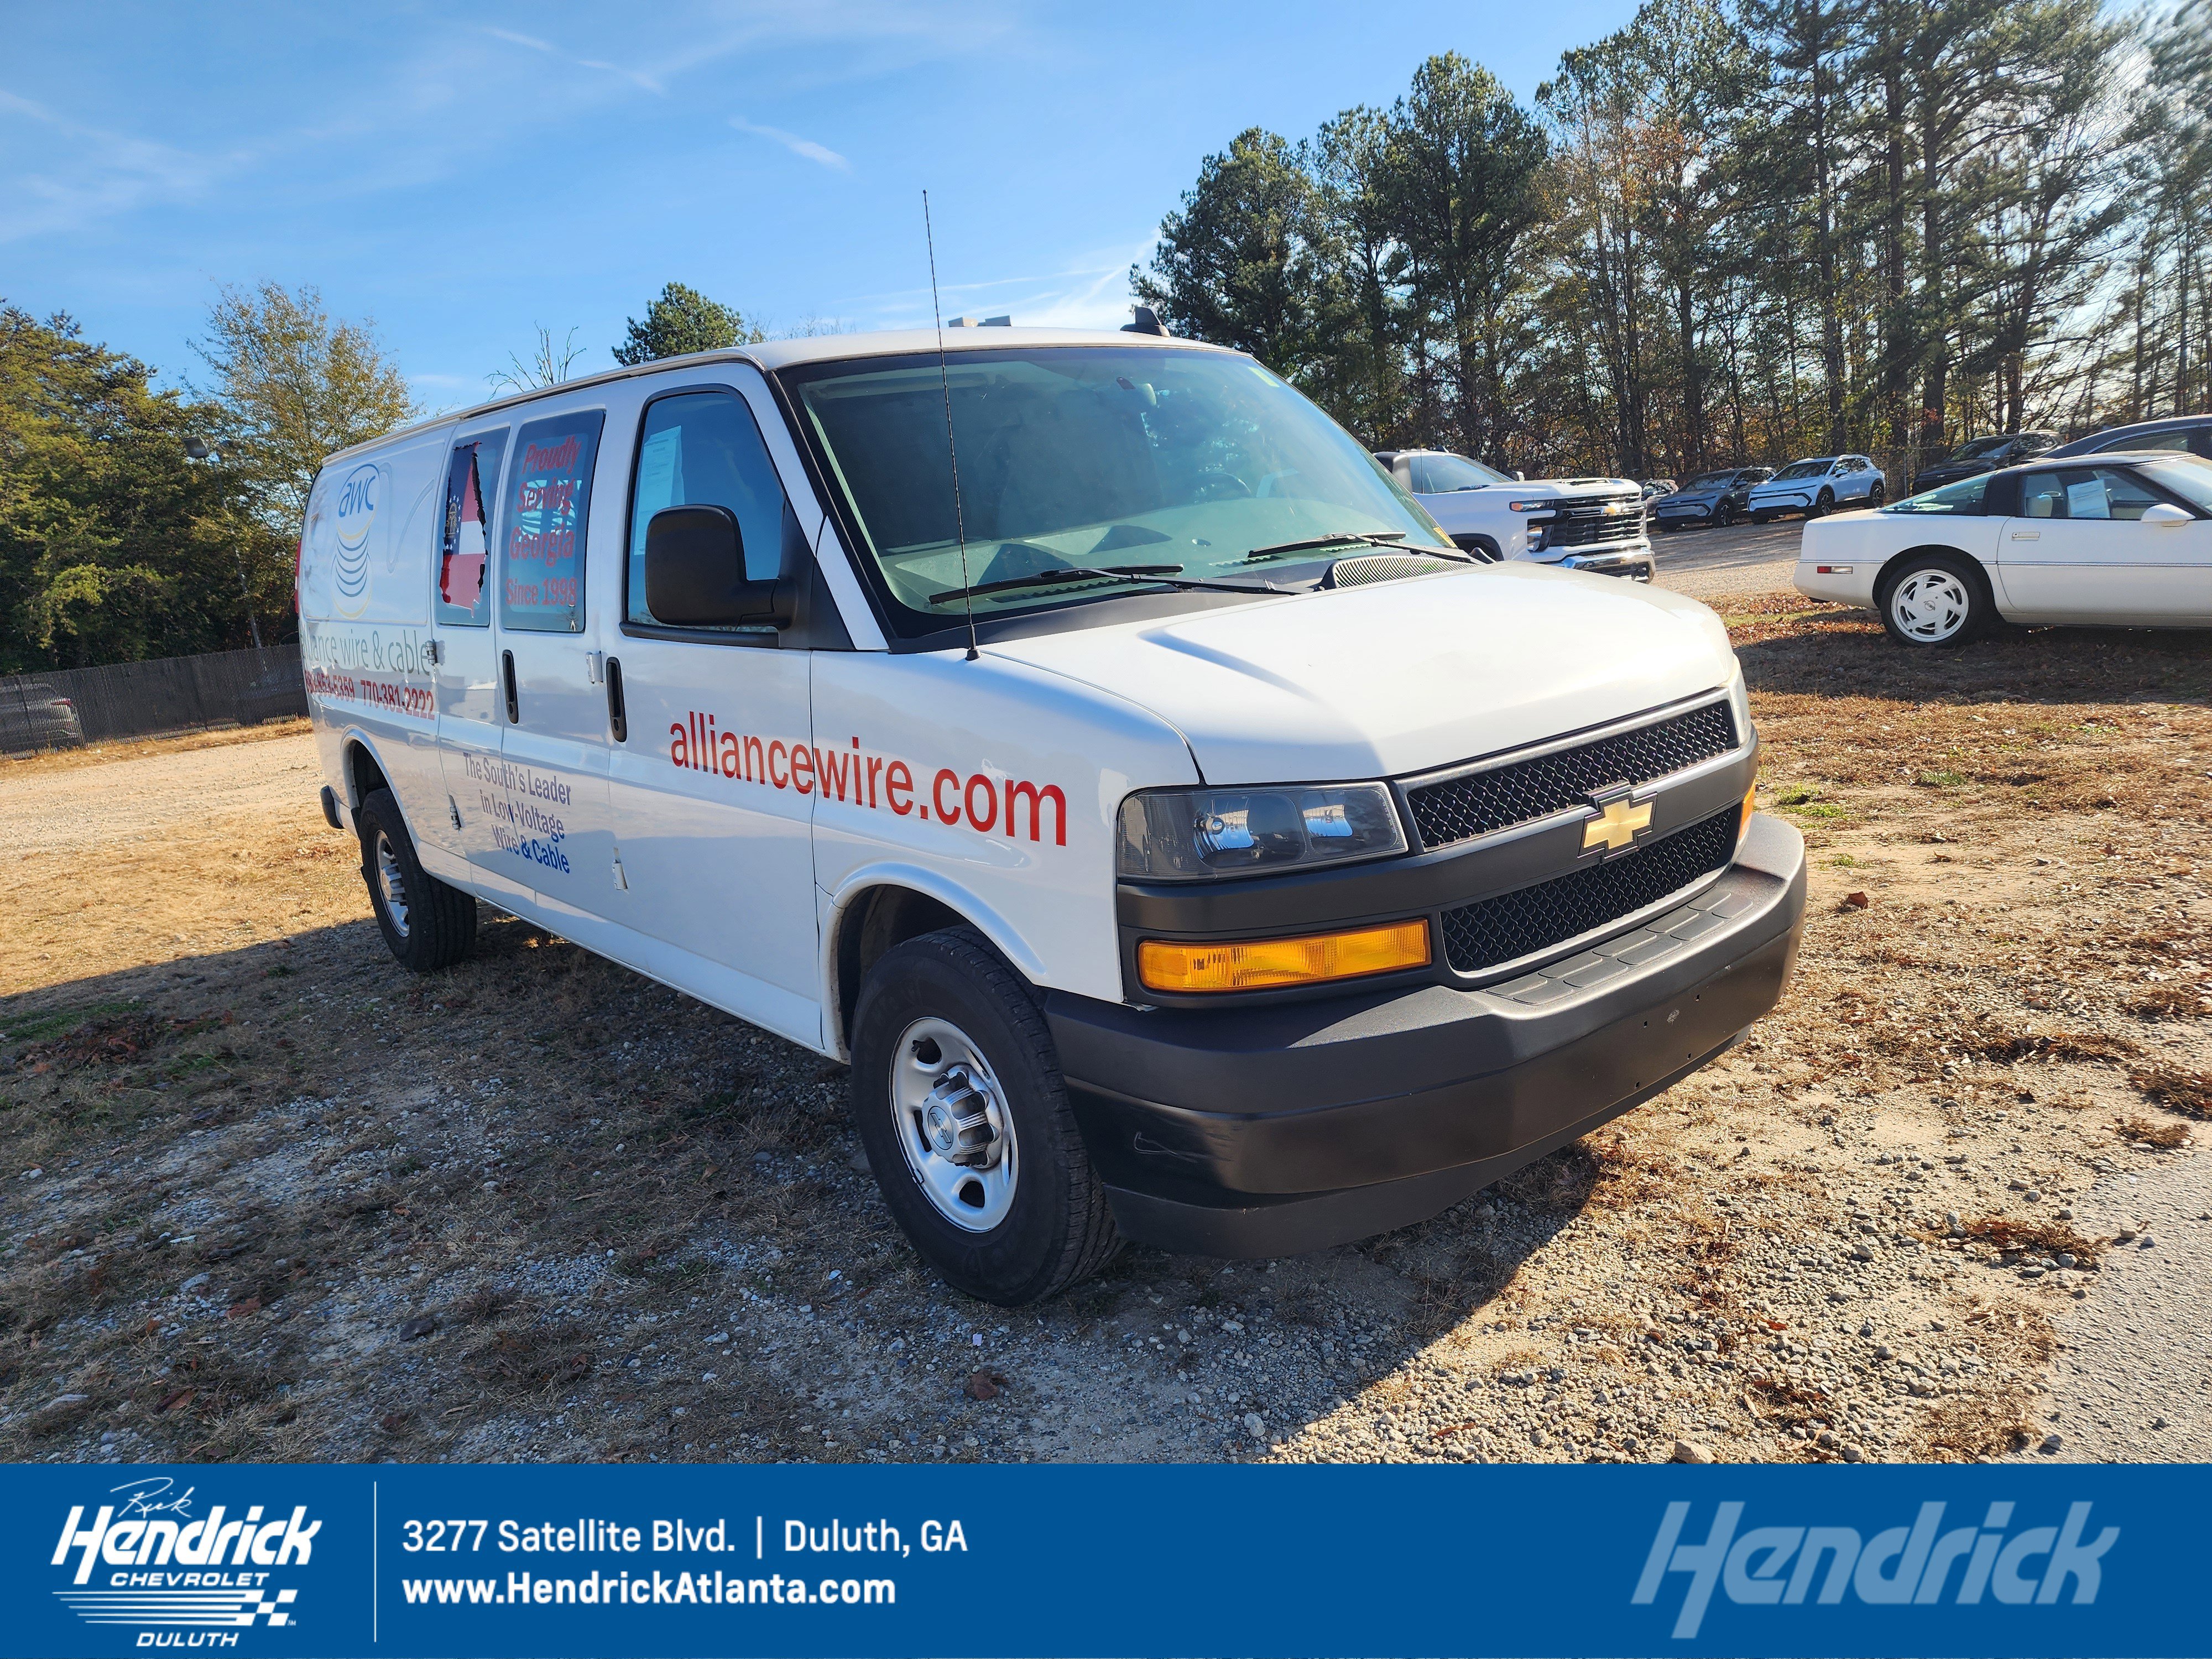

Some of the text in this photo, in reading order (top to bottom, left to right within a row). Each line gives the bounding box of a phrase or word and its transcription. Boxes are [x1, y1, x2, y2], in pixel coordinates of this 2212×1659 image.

[523, 435, 581, 474] Proudly
[517, 477, 576, 515] Serving
[509, 522, 574, 567] Georgia
[505, 578, 577, 606] Since 1998
[340, 628, 369, 667] wire
[372, 630, 385, 670] &
[388, 629, 431, 676] cable
[360, 679, 435, 721] 770-381-2222
[463, 752, 482, 780] The
[528, 769, 571, 806] Leader
[670, 711, 1067, 847] alliancewire.com
[479, 789, 565, 843] in Low-Voltage
[491, 823, 570, 874] Wire & Cable
